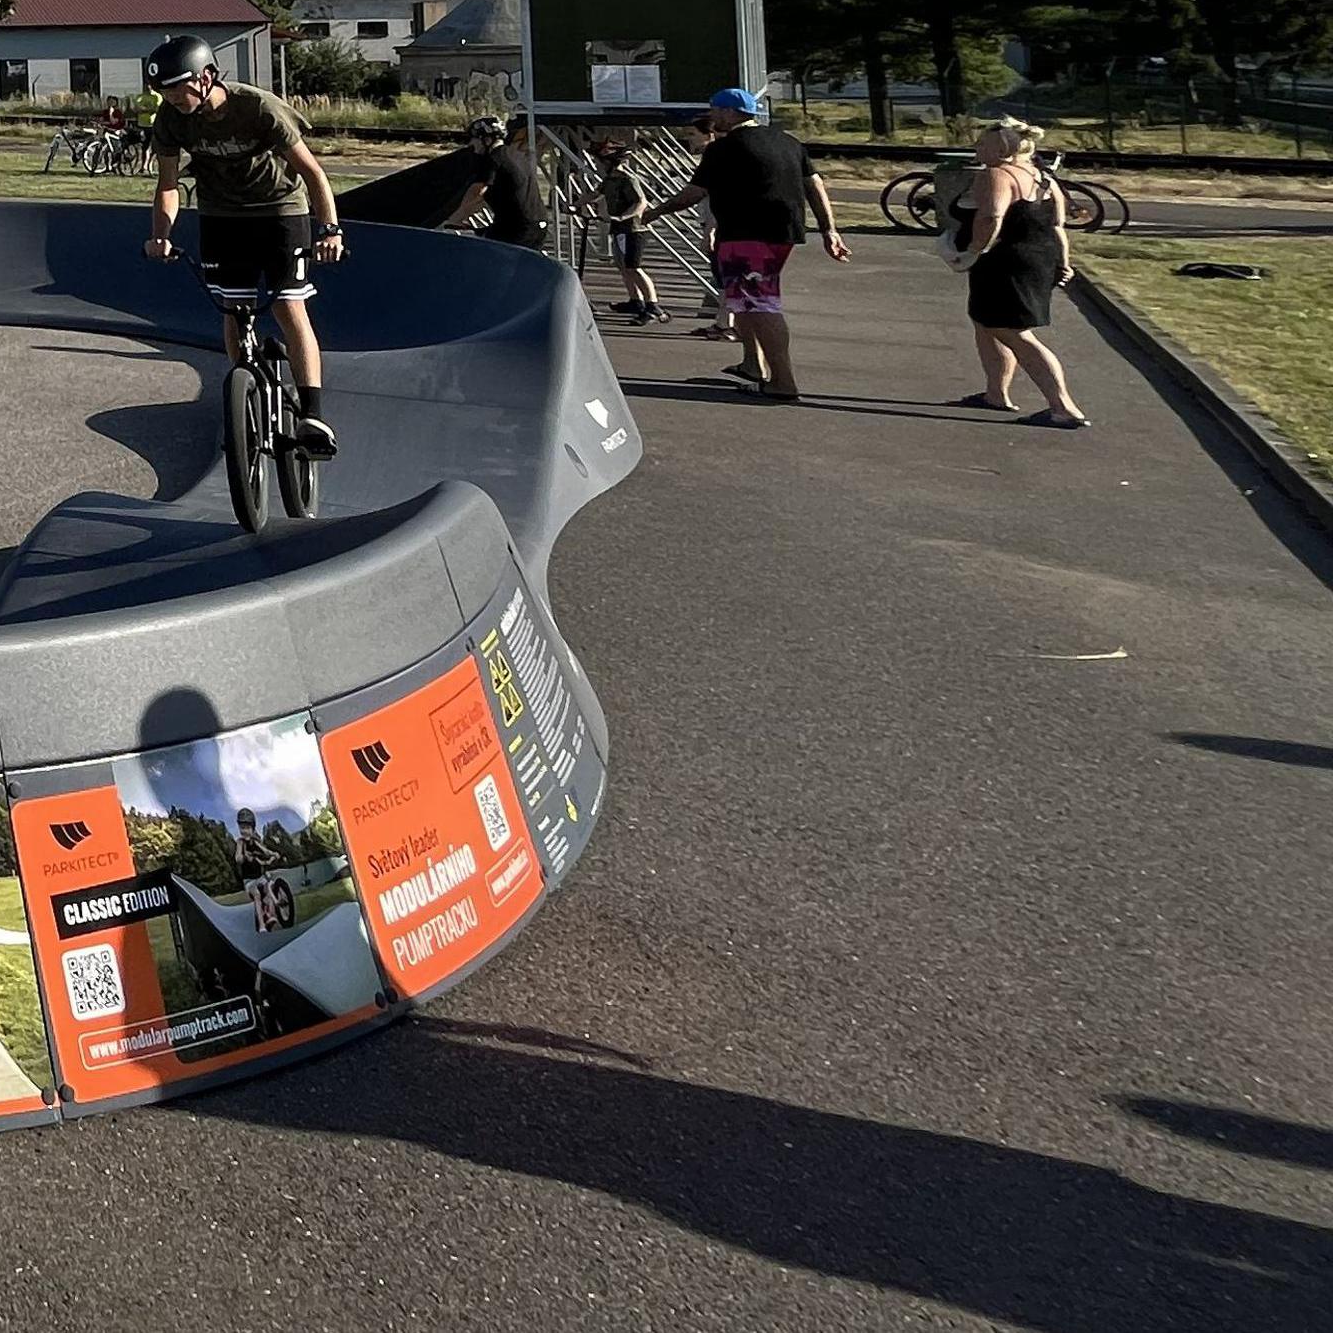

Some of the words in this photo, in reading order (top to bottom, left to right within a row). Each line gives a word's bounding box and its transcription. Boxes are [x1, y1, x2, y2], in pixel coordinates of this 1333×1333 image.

[368, 835, 411, 878] Světový
[410, 827, 440, 861] leader
[63, 894, 122, 926] CLASSIC
[122, 885, 169, 913] EDITION
[379, 843, 477, 925] MODULÁRNÍHO
[393, 896, 478, 971] PUMPTRACKU
[88, 1006, 249, 1059] www.modularpumptrack.com
